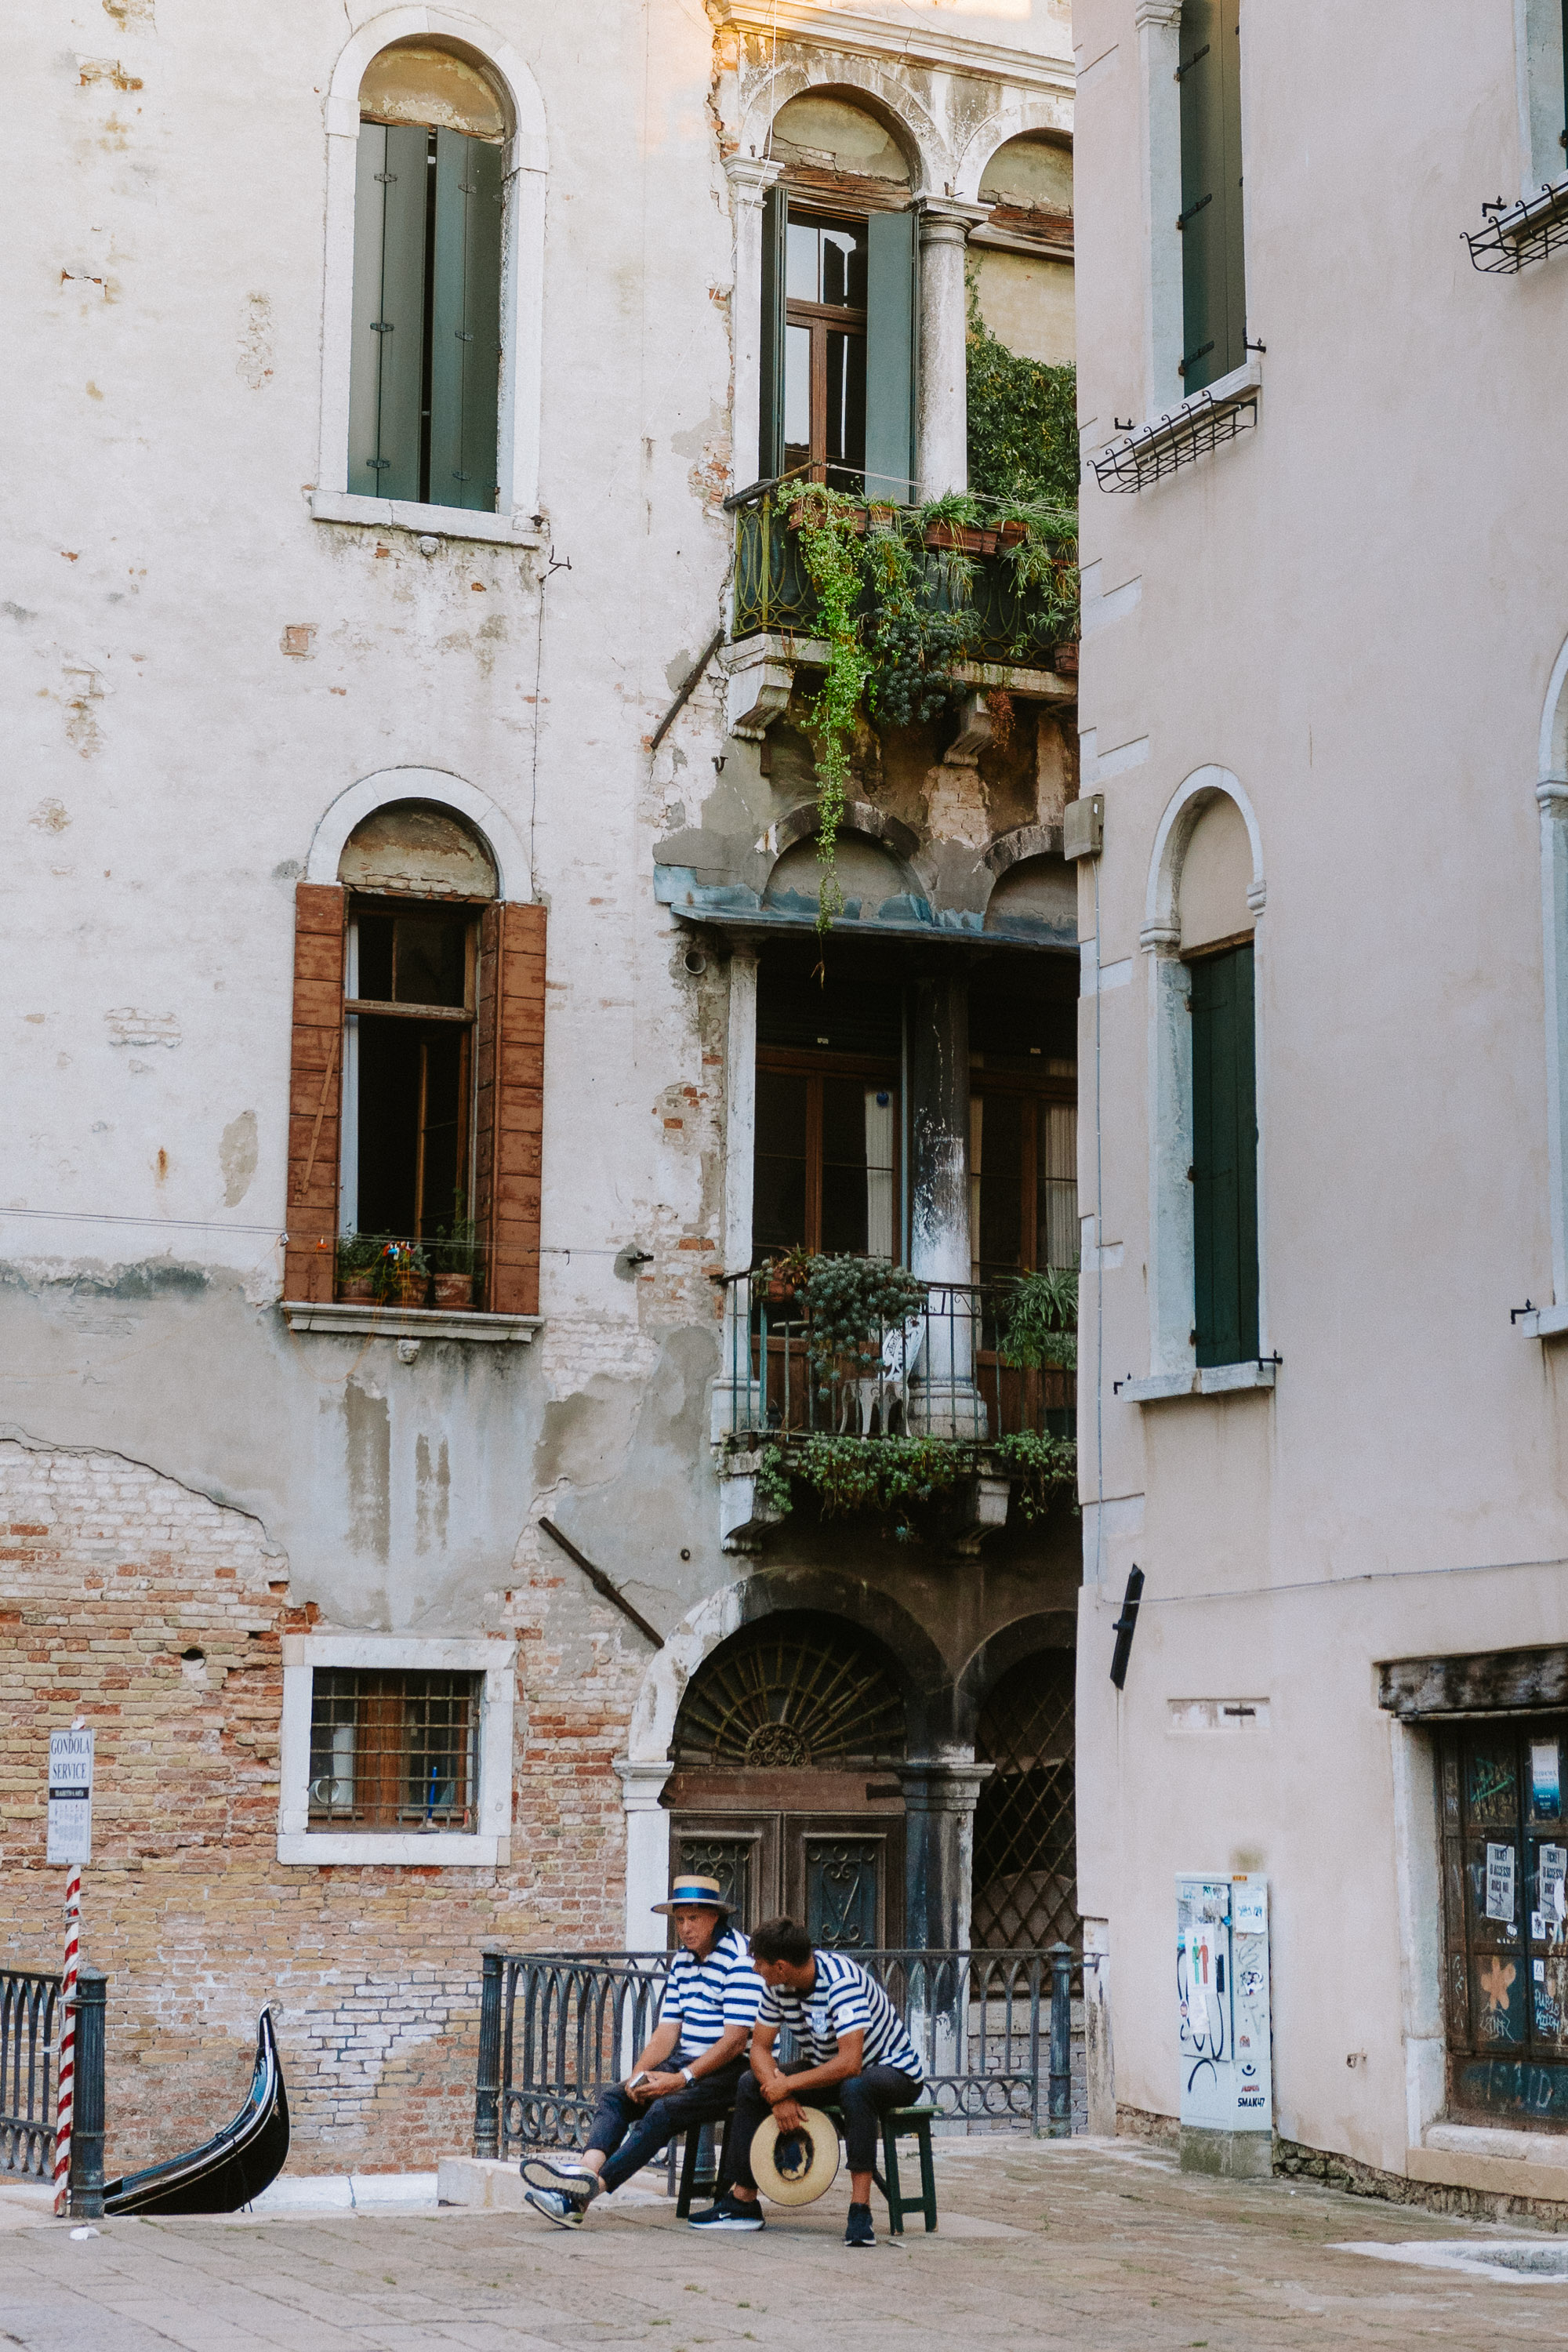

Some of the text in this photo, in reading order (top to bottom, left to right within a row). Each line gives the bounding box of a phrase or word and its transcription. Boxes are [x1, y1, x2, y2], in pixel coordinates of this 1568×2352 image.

[51, 1737, 90, 1755] GONDOLA
[53, 1762, 86, 1780] SERVICE
[1237, 2097, 1265, 2108] SMAK47
